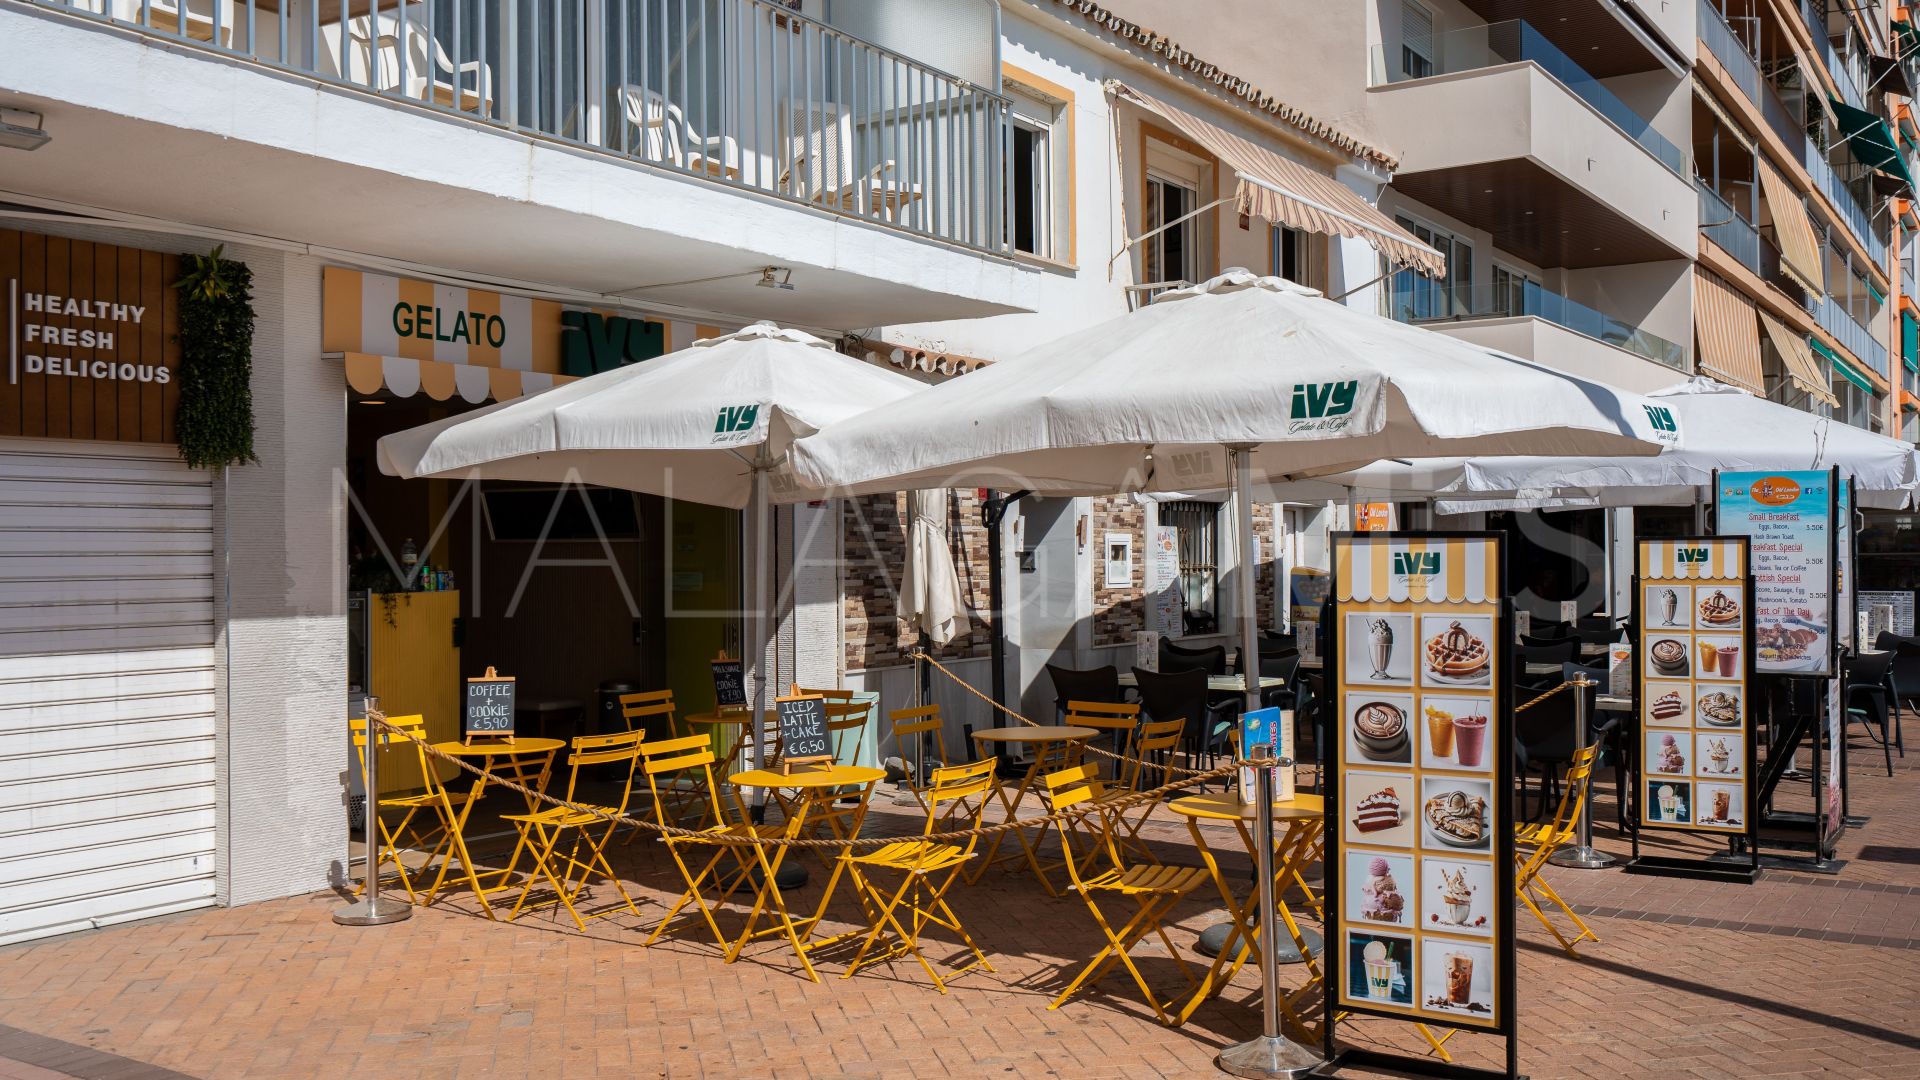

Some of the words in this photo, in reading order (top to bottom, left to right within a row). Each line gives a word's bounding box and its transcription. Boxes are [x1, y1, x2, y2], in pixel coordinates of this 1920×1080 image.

[24, 293, 146, 323] HEALTHY
[393, 302, 505, 348] GELATO
[24, 324, 114, 350] FRESH
[24, 355, 170, 384] DELICIOUS
[1291, 380, 1358, 419] ivy
[715, 404, 760, 433] ivy
[1642, 404, 1677, 432] ivy
[1748, 512, 1766, 521] Small
[1769, 512, 1800, 521] Breakfast
[1678, 548, 1709, 563] ivy
[1751, 543, 1777, 551] reakfast
[1780, 543, 1803, 553] Special
[1393, 552, 1441, 575] ivy
[1756, 574, 1775, 582] ottish
[1777, 574, 1801, 584] Special
[1783, 607, 1795, 615] The
[1797, 607, 1810, 618] Day
[470, 684, 511, 696] COFFEE
[783, 701, 814, 713] ICED
[782, 712, 821, 726] LATTE
